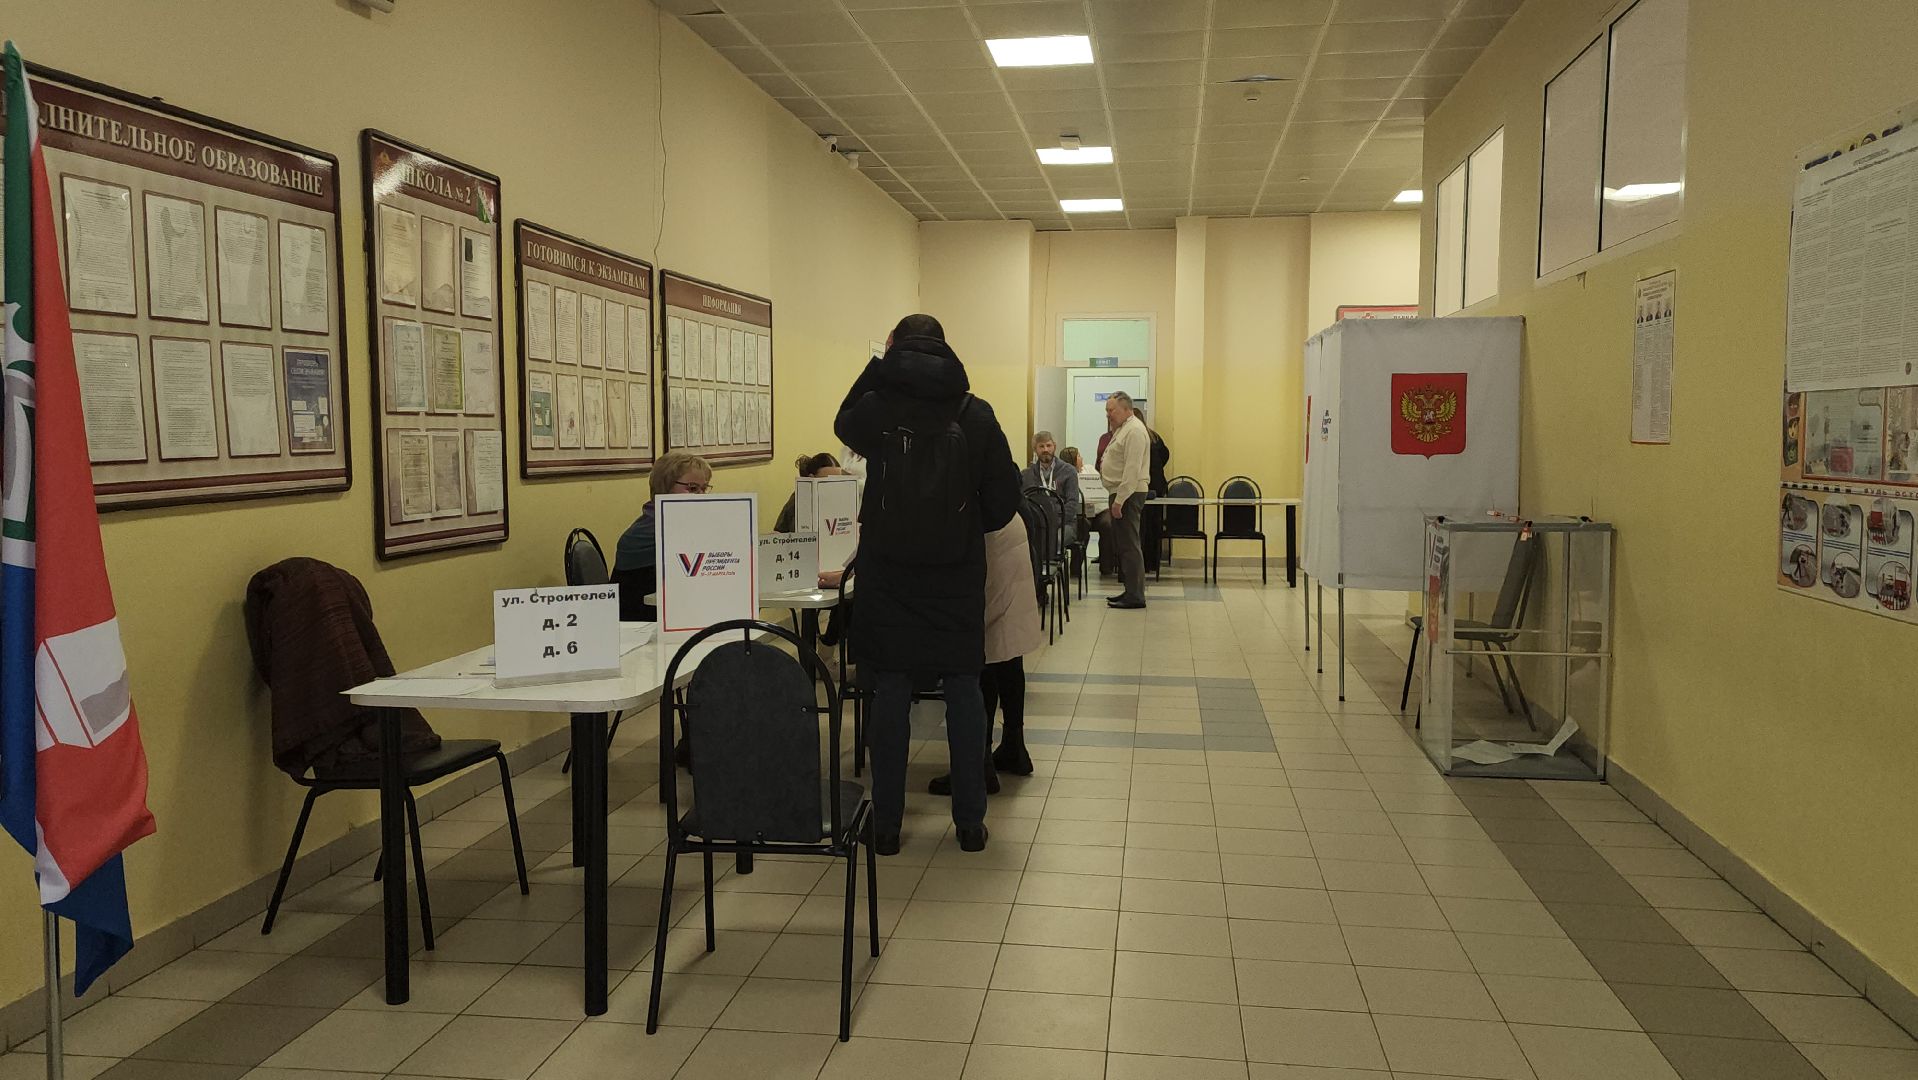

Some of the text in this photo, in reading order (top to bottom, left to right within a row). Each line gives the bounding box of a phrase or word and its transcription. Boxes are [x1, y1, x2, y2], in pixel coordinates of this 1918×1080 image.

[39, 101, 324, 196] ЛНИТЕЛЬНОЕ ОБРАЗОВАНИЕ
[402, 163, 454, 199] ШКОЛА
[465, 186, 471, 205] 2
[527, 240, 646, 291] ГОТОВИМСЯ К ЭКЗАМЕНАМ
[759, 535, 817, 546] ул. Строителей
[776, 551, 800, 563] д. 14
[776, 569, 800, 581] д. 18
[501, 588, 616, 607] ул. Строителей
[542, 613, 578, 631] д. 2
[542, 640, 578, 658] д. 6
